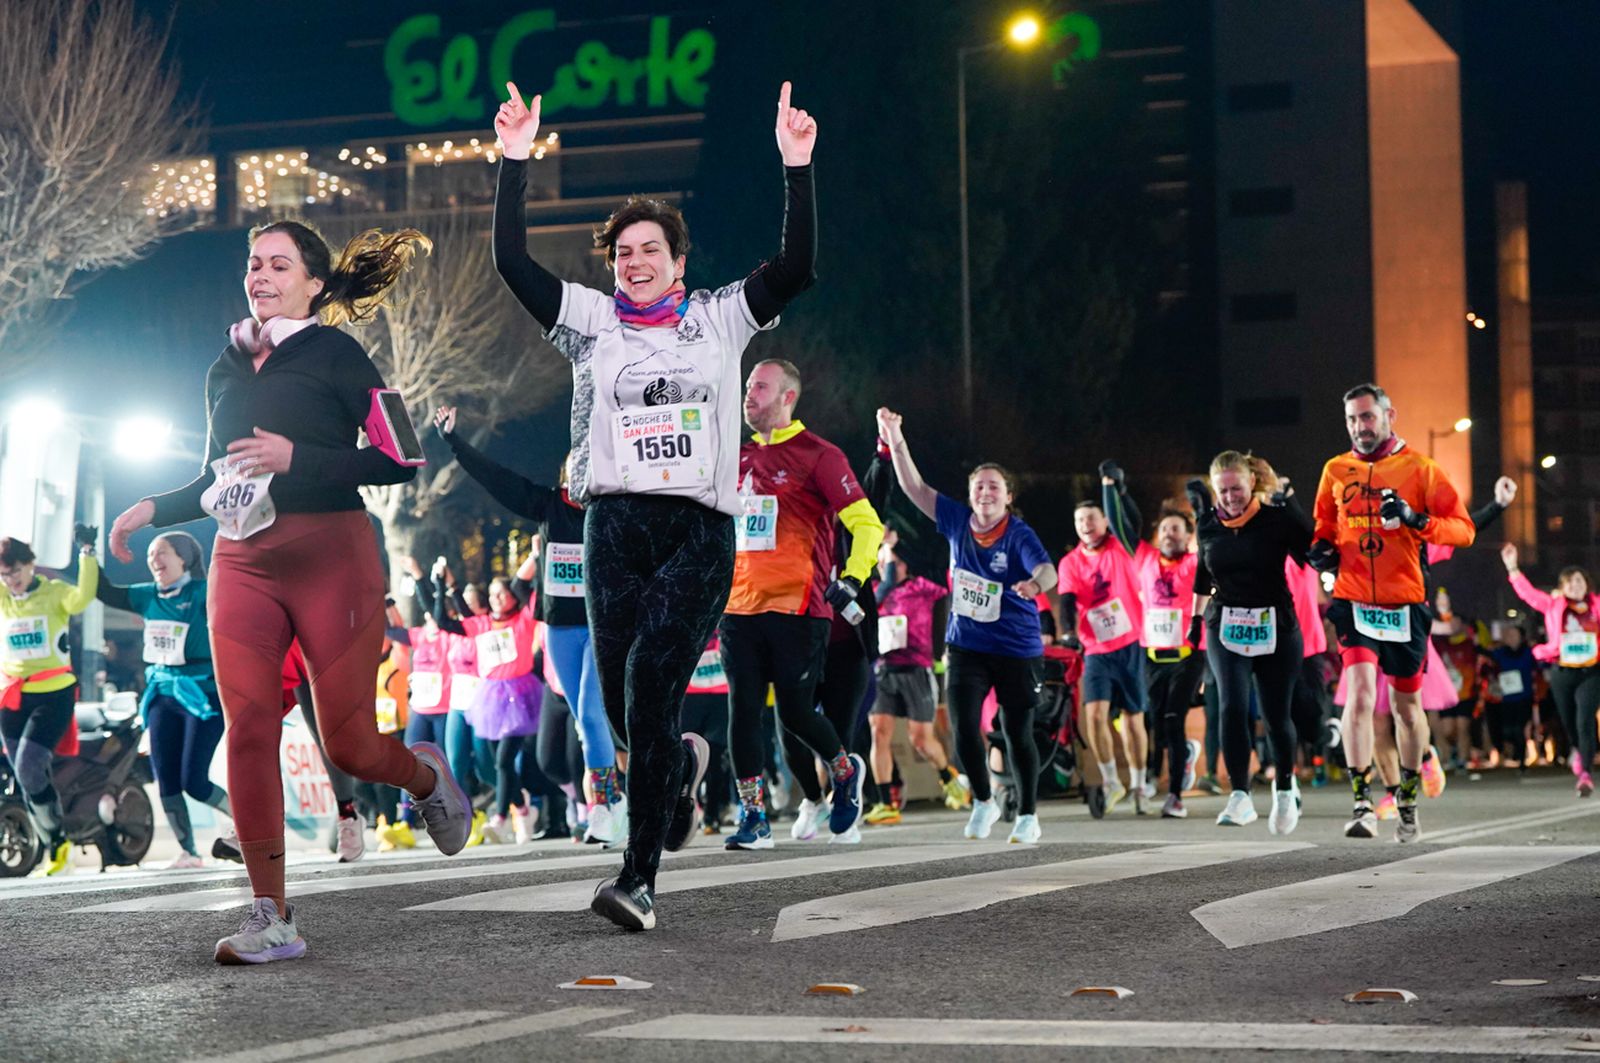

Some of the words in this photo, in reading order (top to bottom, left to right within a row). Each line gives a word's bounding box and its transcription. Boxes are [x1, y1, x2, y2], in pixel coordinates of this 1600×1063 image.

[385, 13, 485, 126] El
[489, 8, 717, 118] Corte
[633, 415, 661, 426] NOCHE
[662, 413, 673, 423] DE
[623, 428, 641, 439] SAN
[632, 433, 692, 462] 1550
[962, 586, 991, 607] 3967
[1361, 609, 1401, 628] 13218
[1229, 624, 1268, 641] 13415
